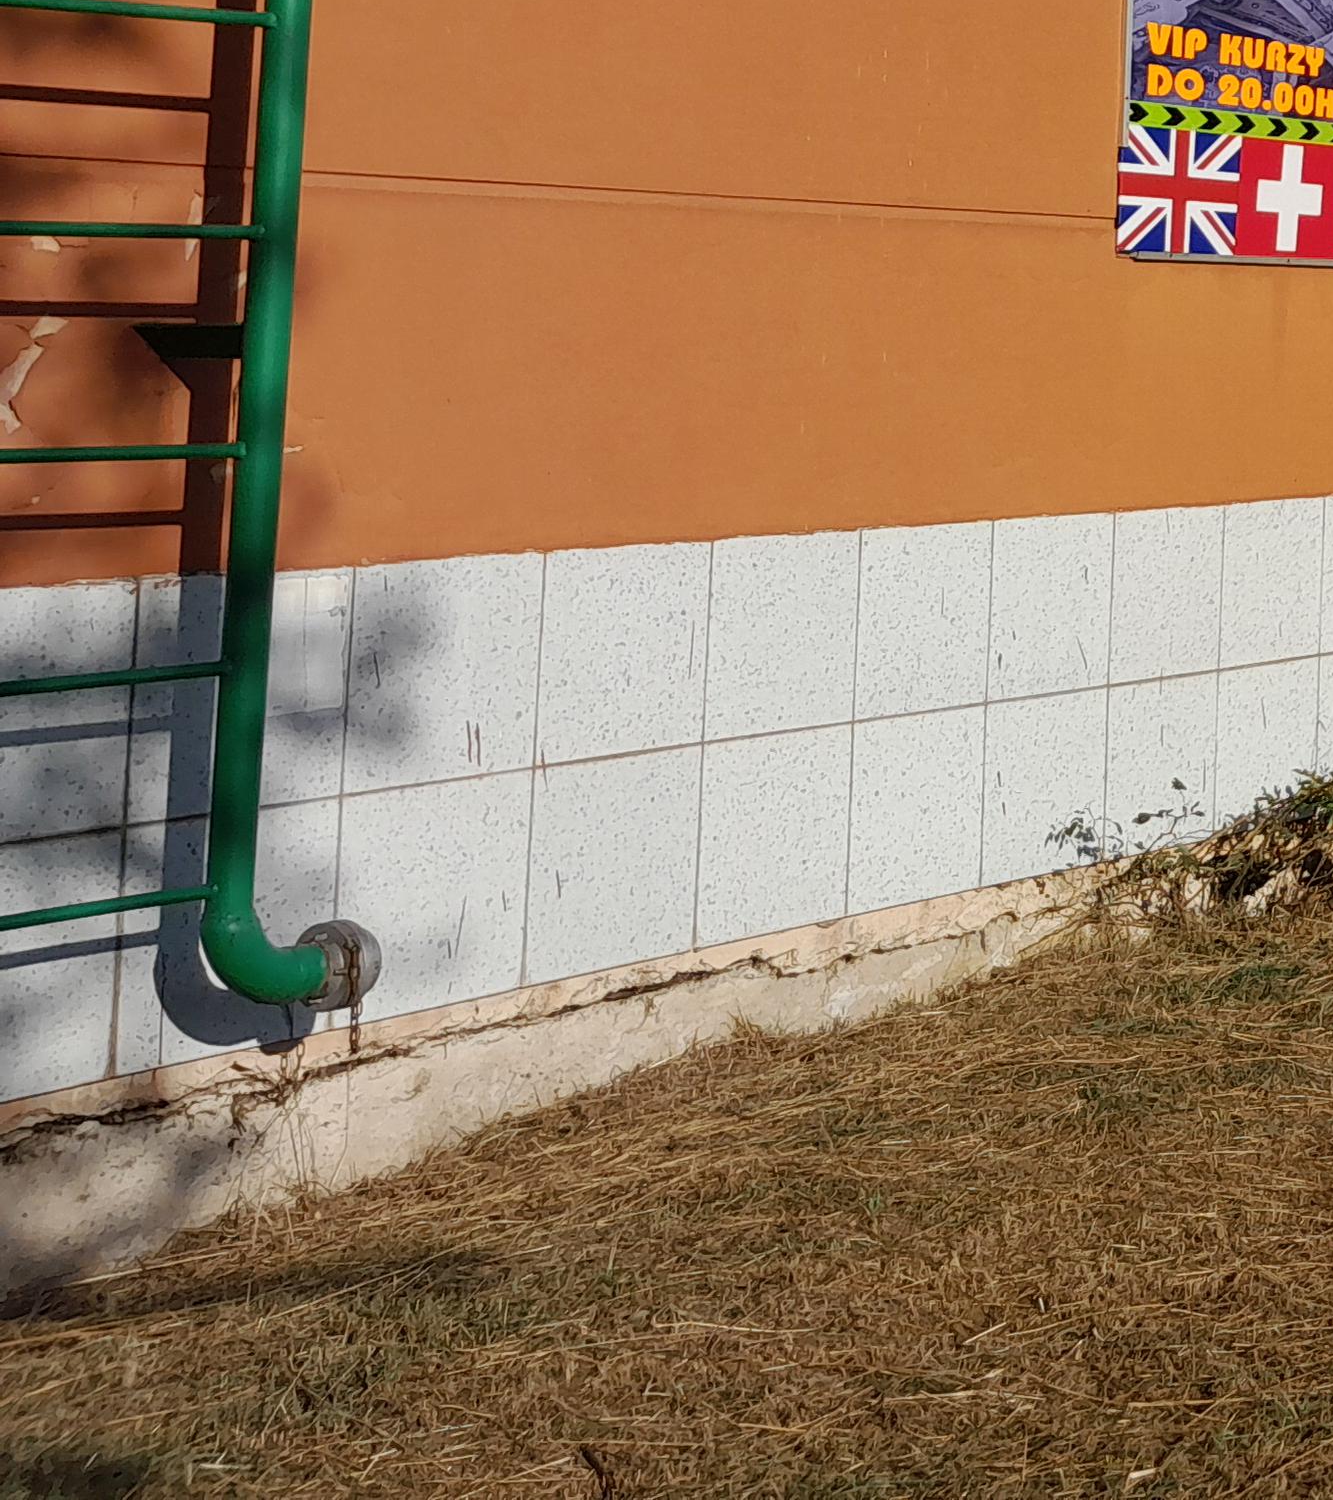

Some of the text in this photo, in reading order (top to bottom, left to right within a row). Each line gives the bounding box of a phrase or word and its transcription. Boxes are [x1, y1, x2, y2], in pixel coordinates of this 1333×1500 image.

[1146, 21, 1325, 77] VIP KURZY
[1146, 63, 1205, 101] DO
